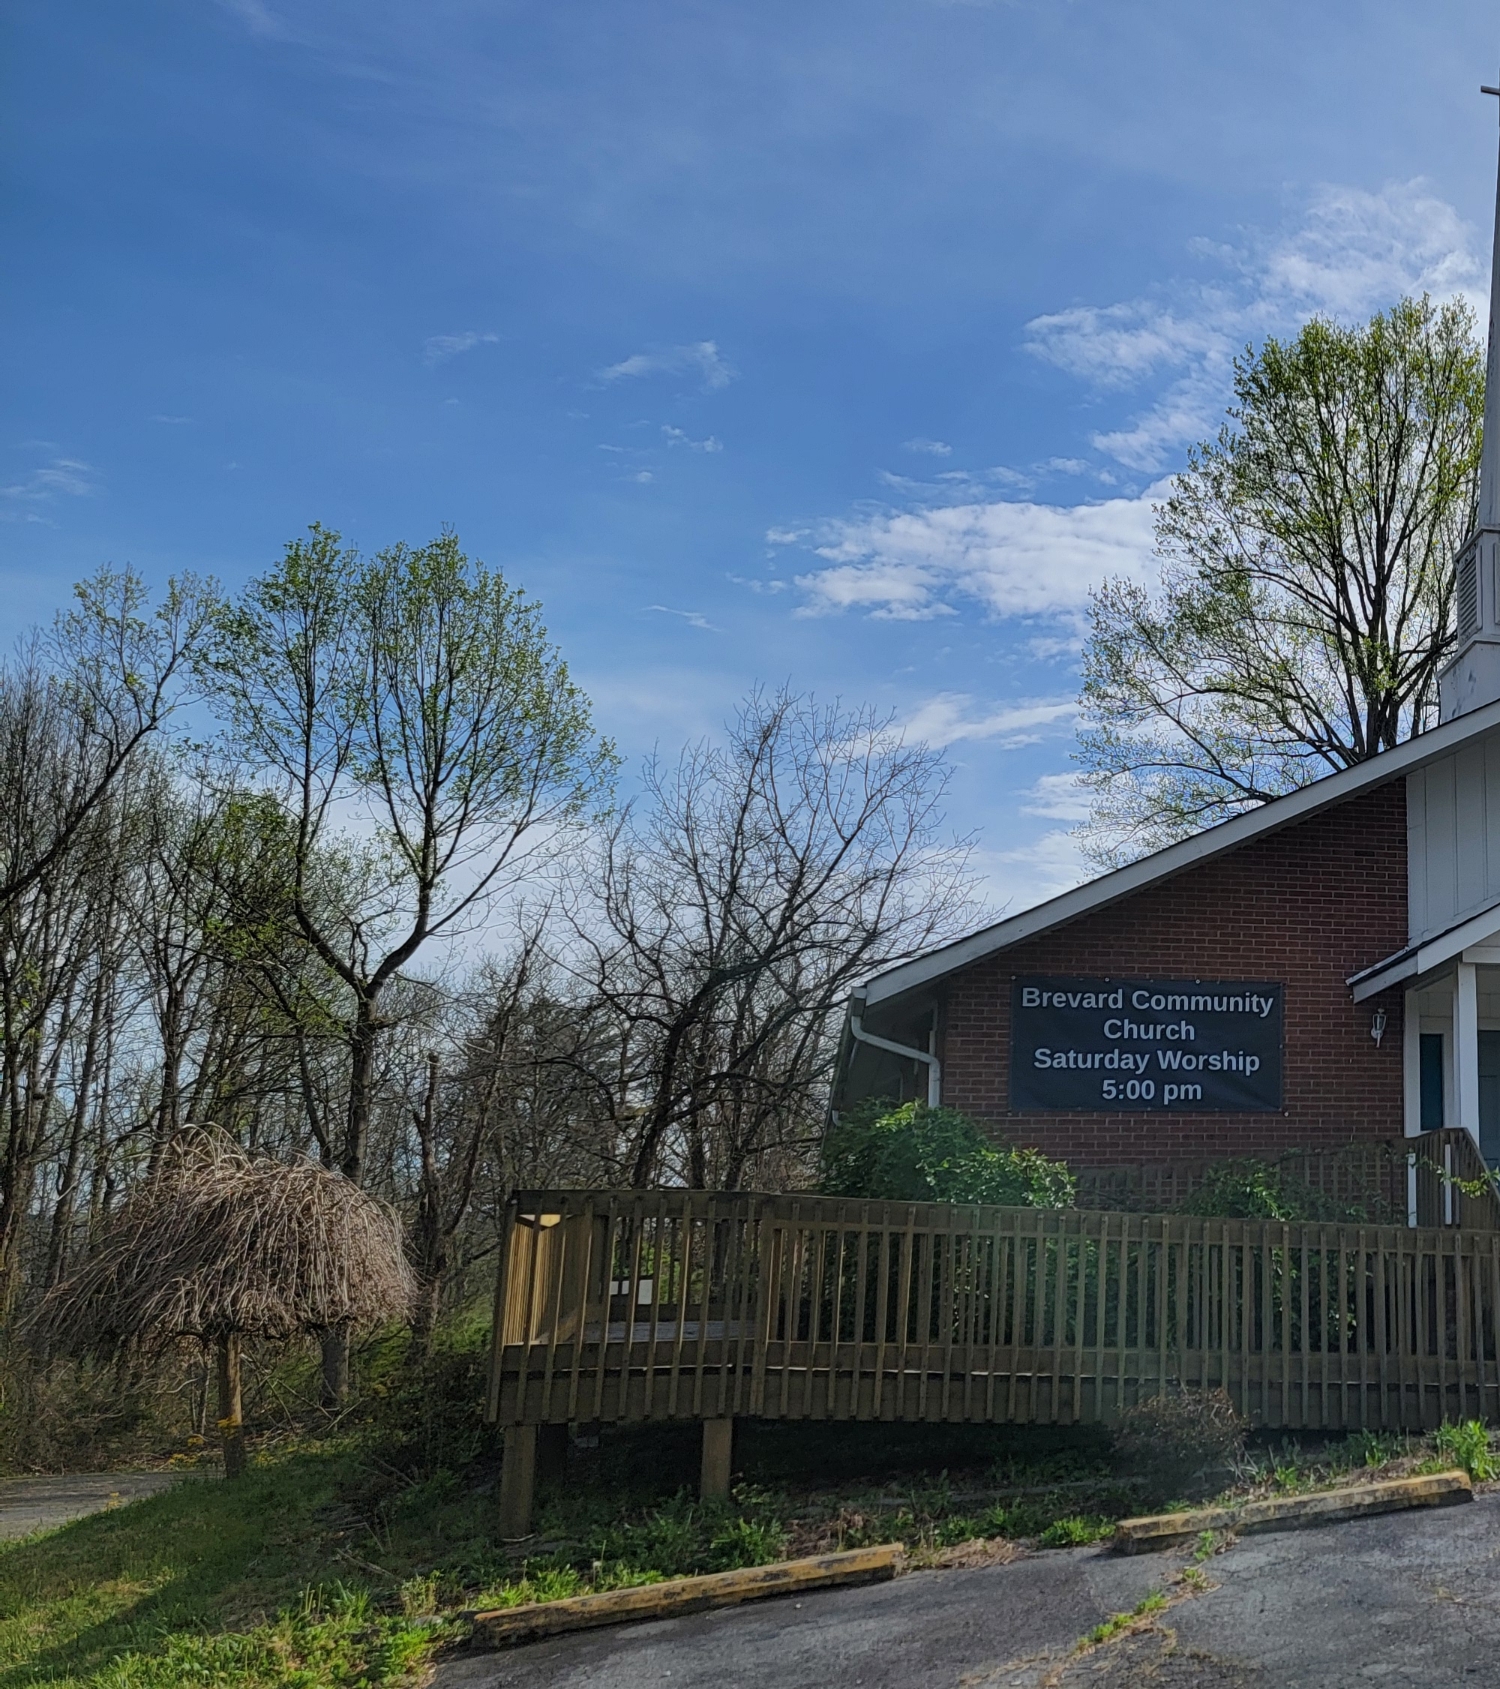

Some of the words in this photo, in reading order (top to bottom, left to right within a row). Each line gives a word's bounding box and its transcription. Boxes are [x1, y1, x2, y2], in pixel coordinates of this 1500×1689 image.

[1022, 987, 1123, 1009] Brevard
[1132, 990, 1274, 1017] Community
[1103, 1019, 1195, 1040] Church
[1033, 1048, 1149, 1074] Saturday
[1157, 1050, 1260, 1076] Worship
[1101, 1079, 1155, 1100] 5:00
[1163, 1083, 1202, 1105] pm
